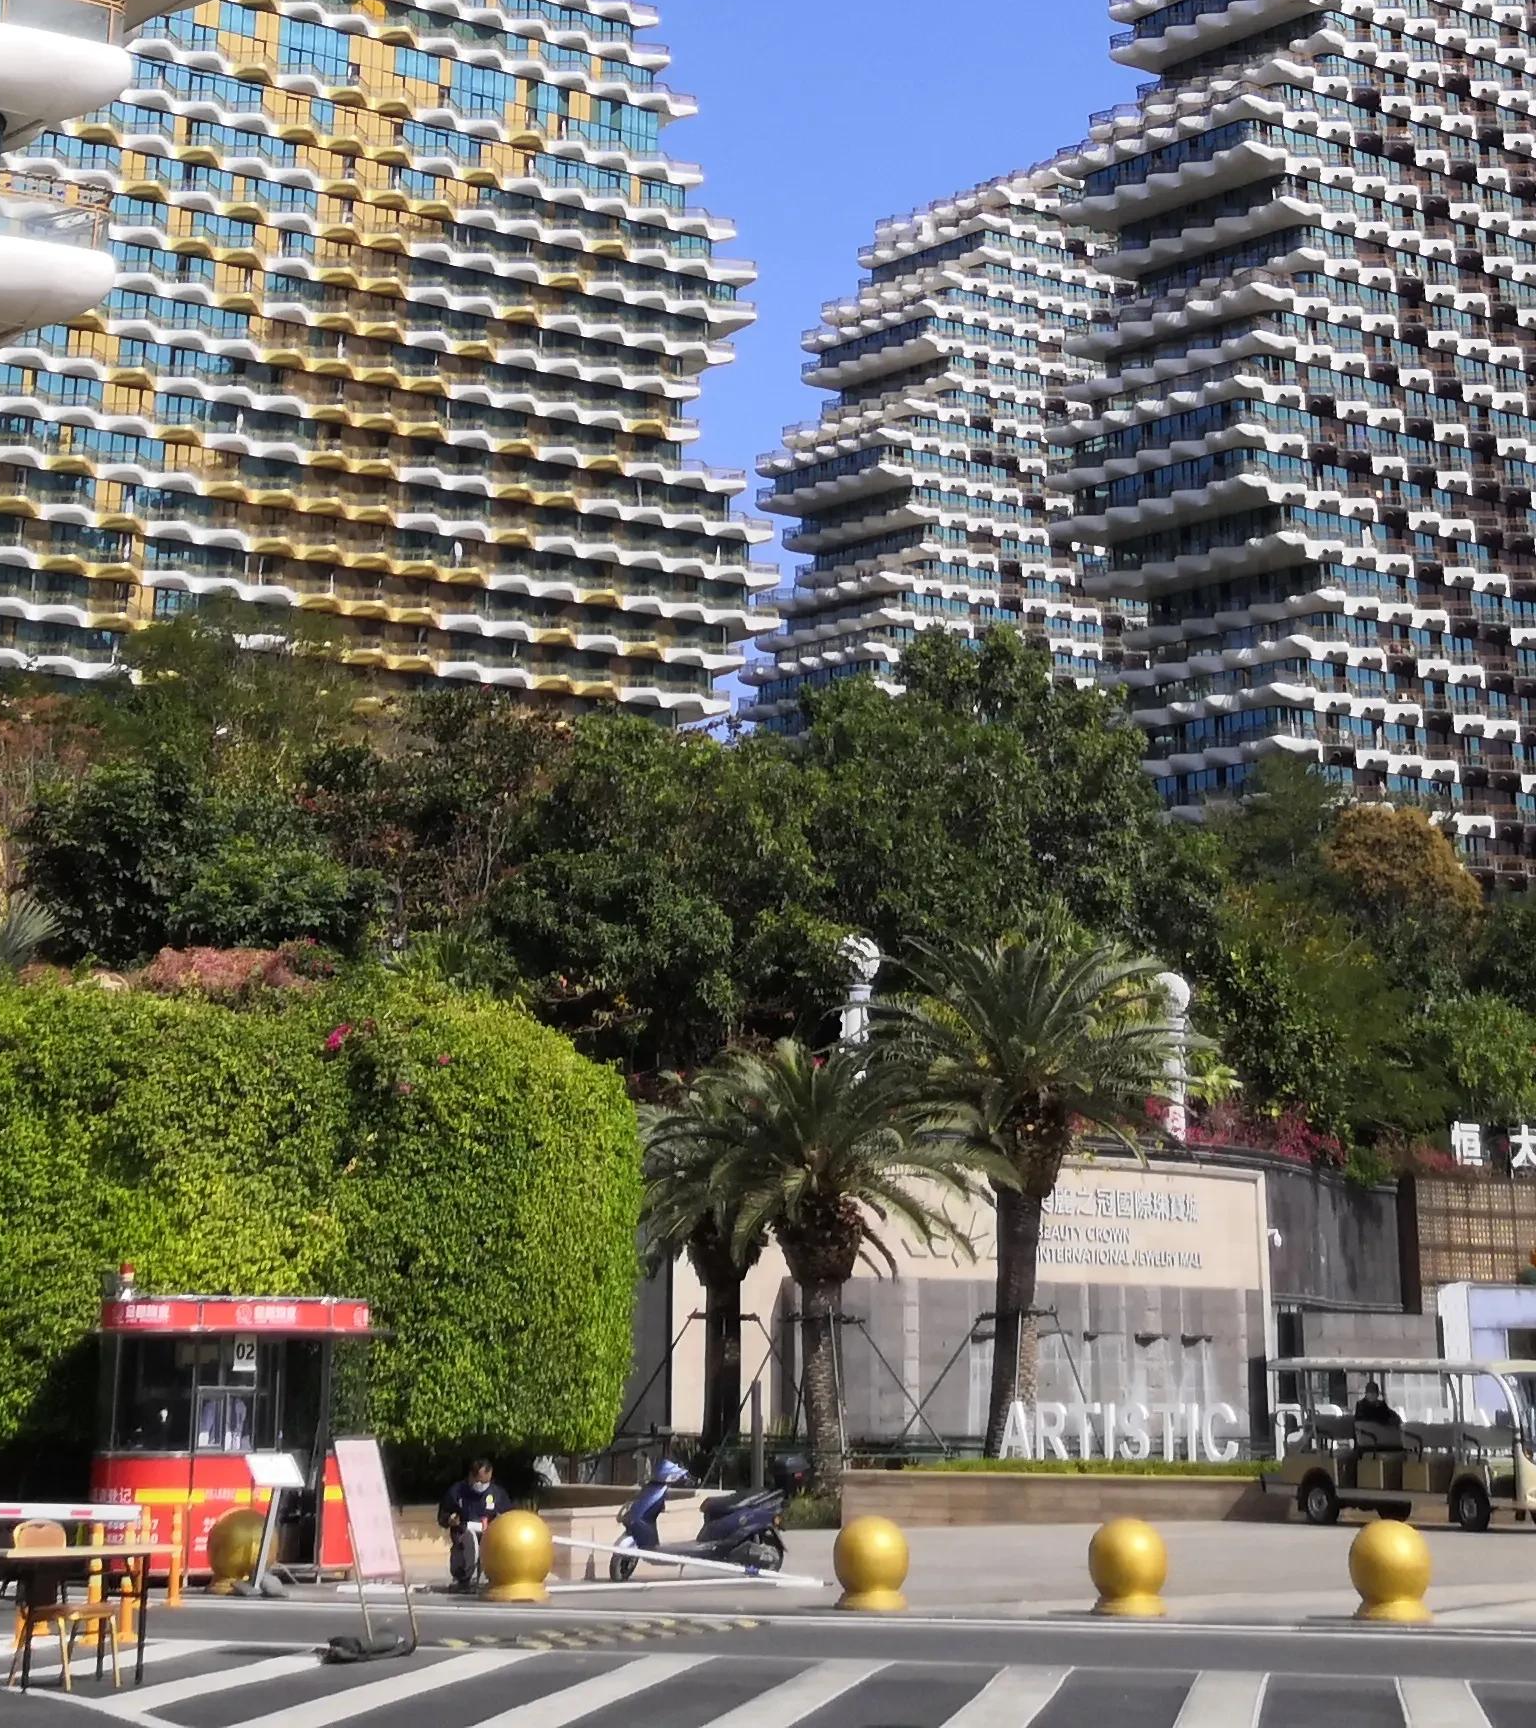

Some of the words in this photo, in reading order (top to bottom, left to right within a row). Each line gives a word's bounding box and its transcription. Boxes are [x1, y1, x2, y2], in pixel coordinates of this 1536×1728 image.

[1085, 1226, 1131, 1245] CROWN
[1036, 1245, 1130, 1267] INTERNATIONAL
[1177, 1251, 1204, 1269] MALL
[236, 1343, 255, 1361] 02
[999, 1401, 1239, 1463] ARTISTIC
